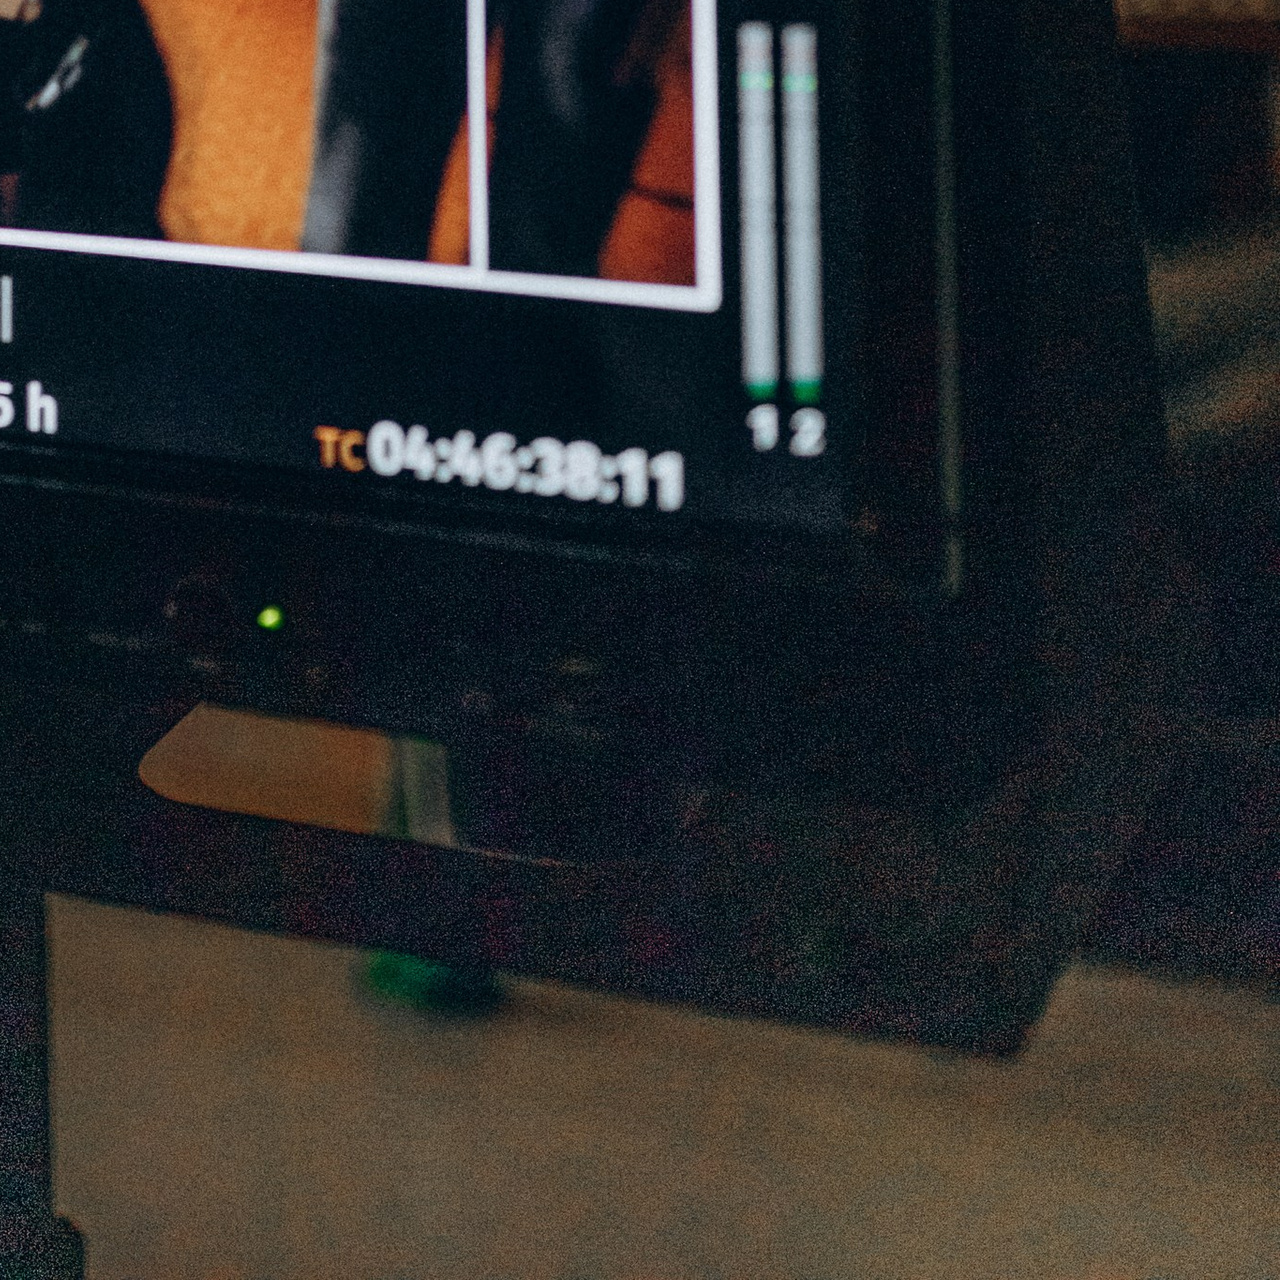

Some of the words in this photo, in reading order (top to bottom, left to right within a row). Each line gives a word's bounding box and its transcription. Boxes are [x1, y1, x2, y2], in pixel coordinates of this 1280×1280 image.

[26, 380, 58, 434] h
[748, 404, 778, 450] 1
[791, 408, 825, 456] 2
[315, 426, 364, 471] TC
